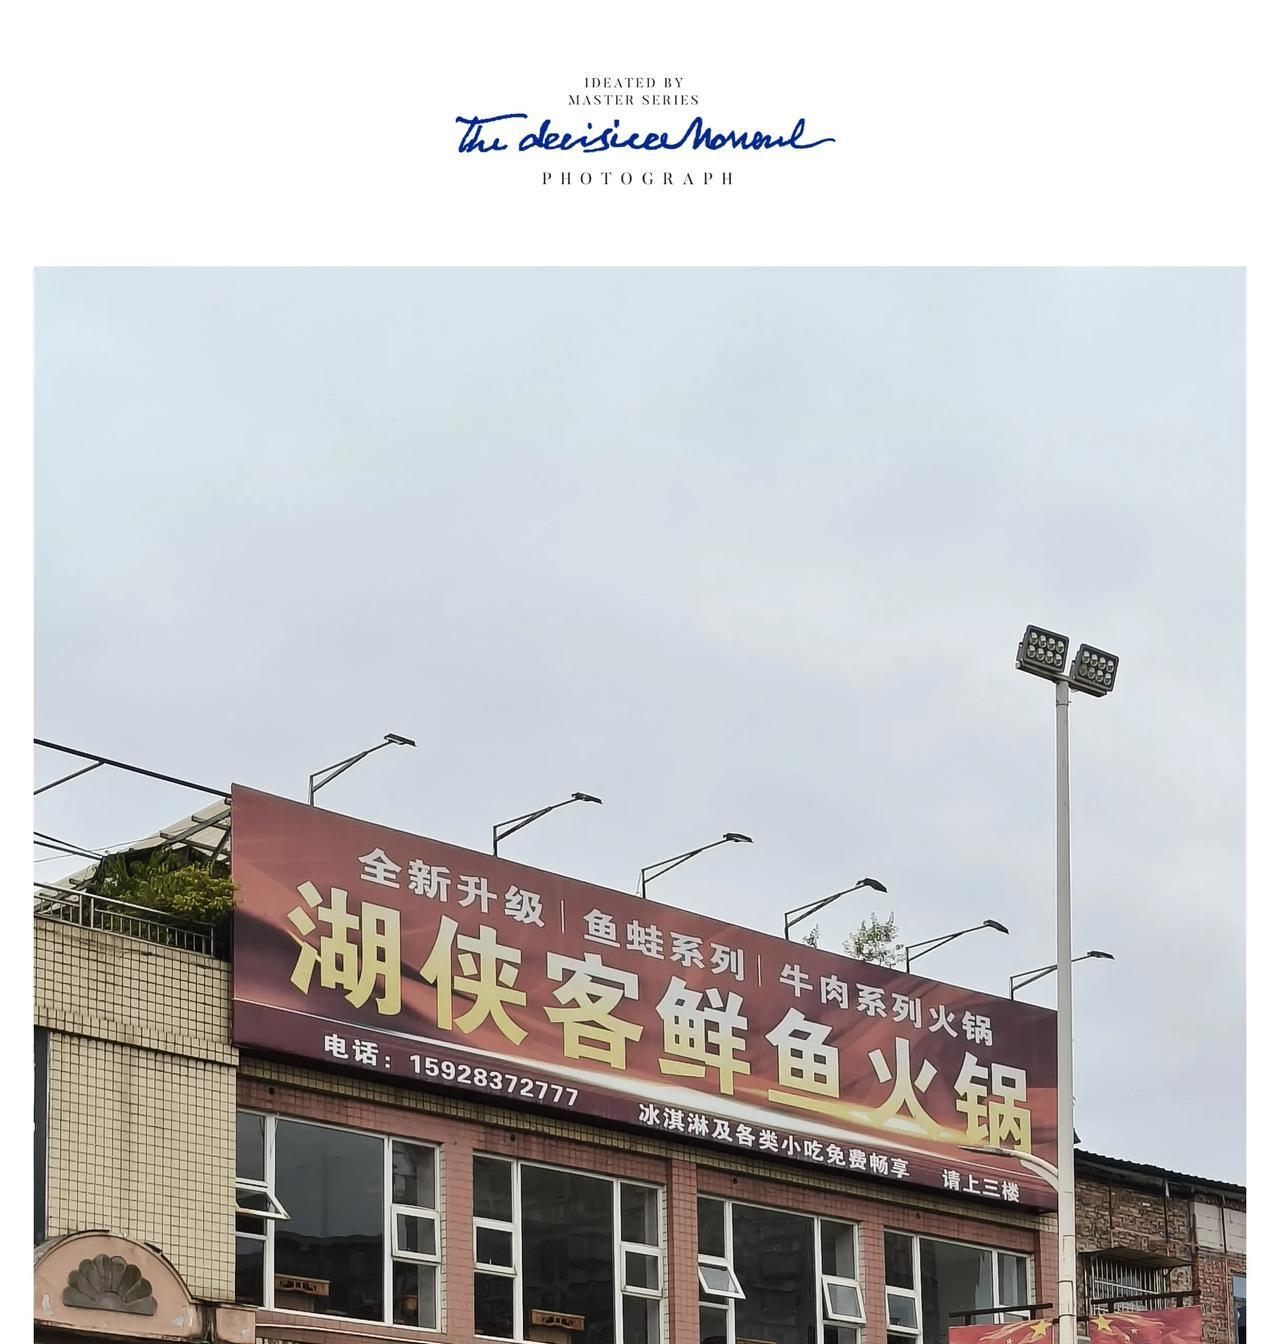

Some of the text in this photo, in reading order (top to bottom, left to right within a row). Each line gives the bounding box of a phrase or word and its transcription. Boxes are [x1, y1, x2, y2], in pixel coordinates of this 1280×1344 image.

[287, 880, 1032, 1154] 湖侠客鲜鱼火锅
[358, 847, 993, 1047] 全新升级 鱼蛙系列 牛肉系列火锅
[410, 1054, 579, 1106] 15928372777
[638, 1103, 910, 1178] 冰淇淋及各类小吃免费畅享
[942, 1168, 1020, 1202] 请上三楼
